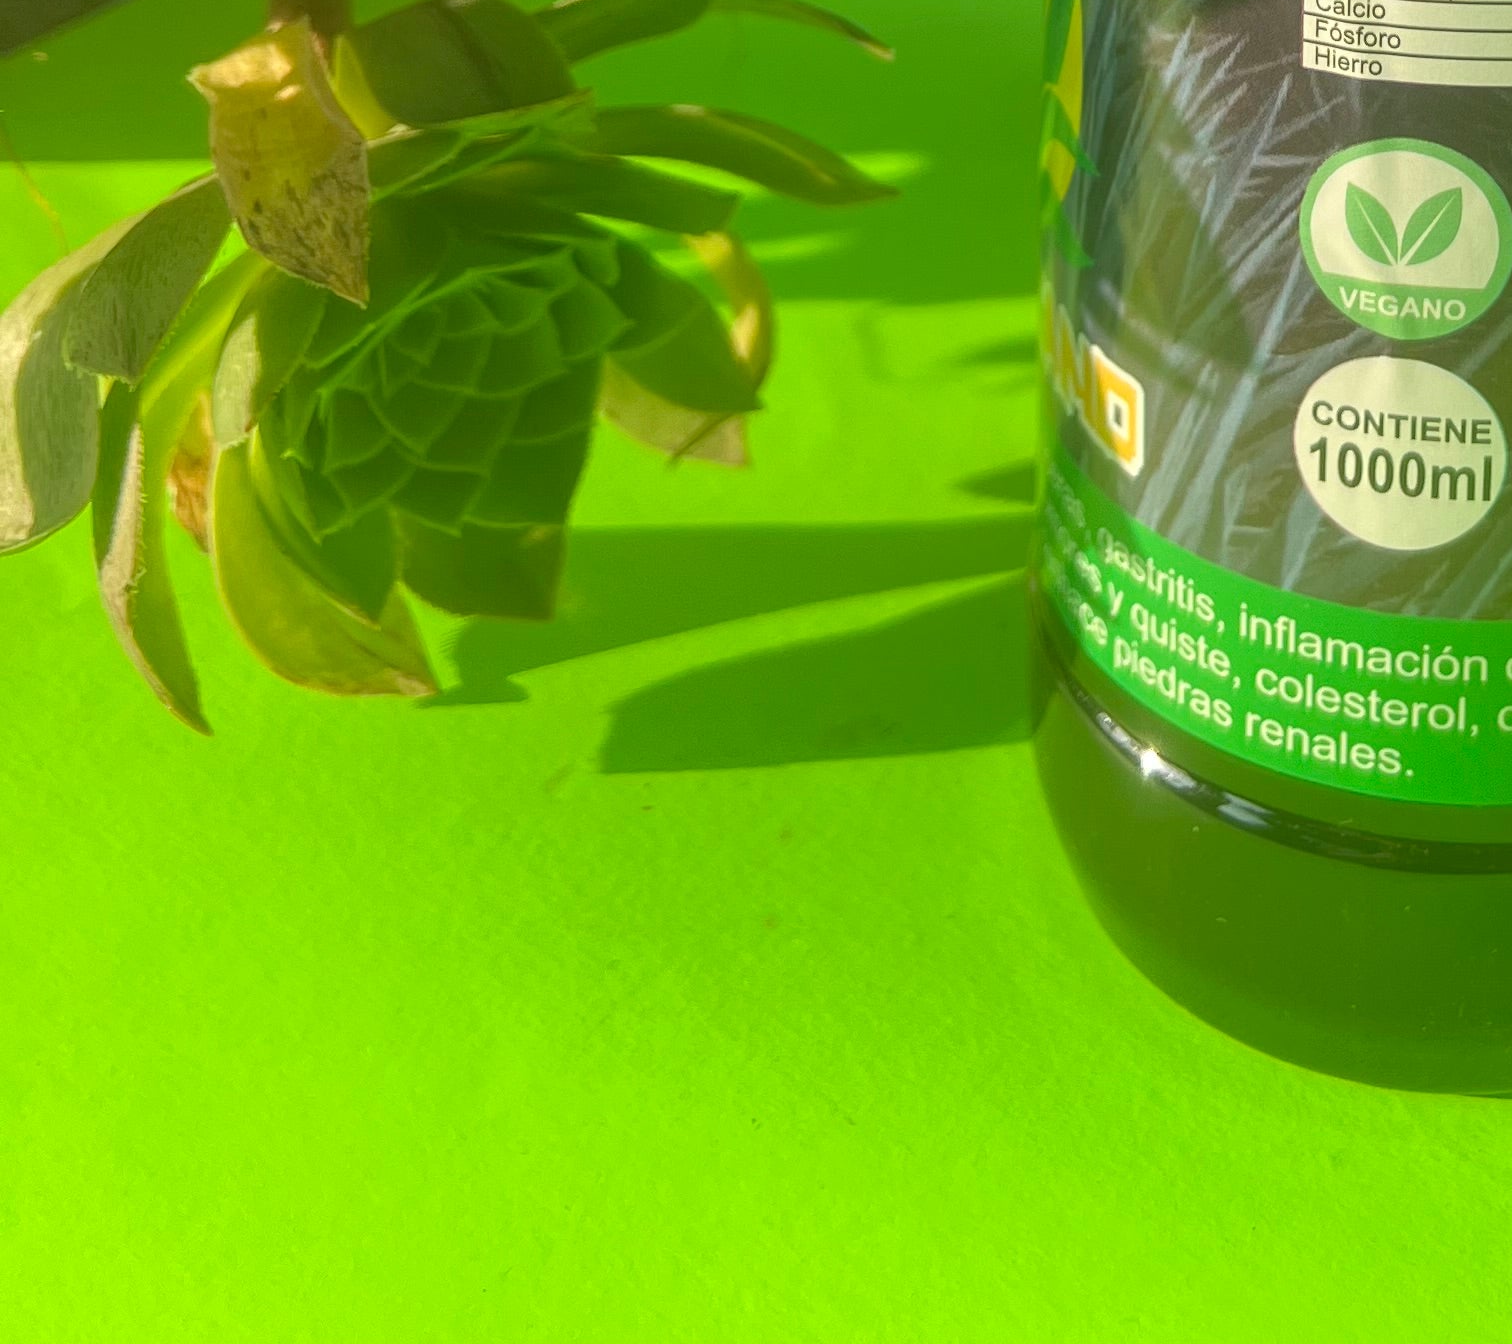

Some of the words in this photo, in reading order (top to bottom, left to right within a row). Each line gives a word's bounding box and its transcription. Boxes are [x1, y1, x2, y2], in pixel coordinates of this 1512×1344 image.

[1314, 46, 1383, 76] Hierro
[1315, 19, 1401, 49] Fósforo
[1338, 286, 1467, 321] VEGANO
[1311, 400, 1493, 444] CONTIENE
[1309, 436, 1493, 502] 1000ml
[1097, 527, 1225, 633] gastritis,
[1238, 603, 1488, 682] inflamación
[1107, 581, 1124, 616] y
[1130, 602, 1242, 689] quiste,
[1255, 666, 1480, 738] colesterol,
[1113, 635, 1233, 728] piedras
[1245, 711, 1415, 778] renales.
